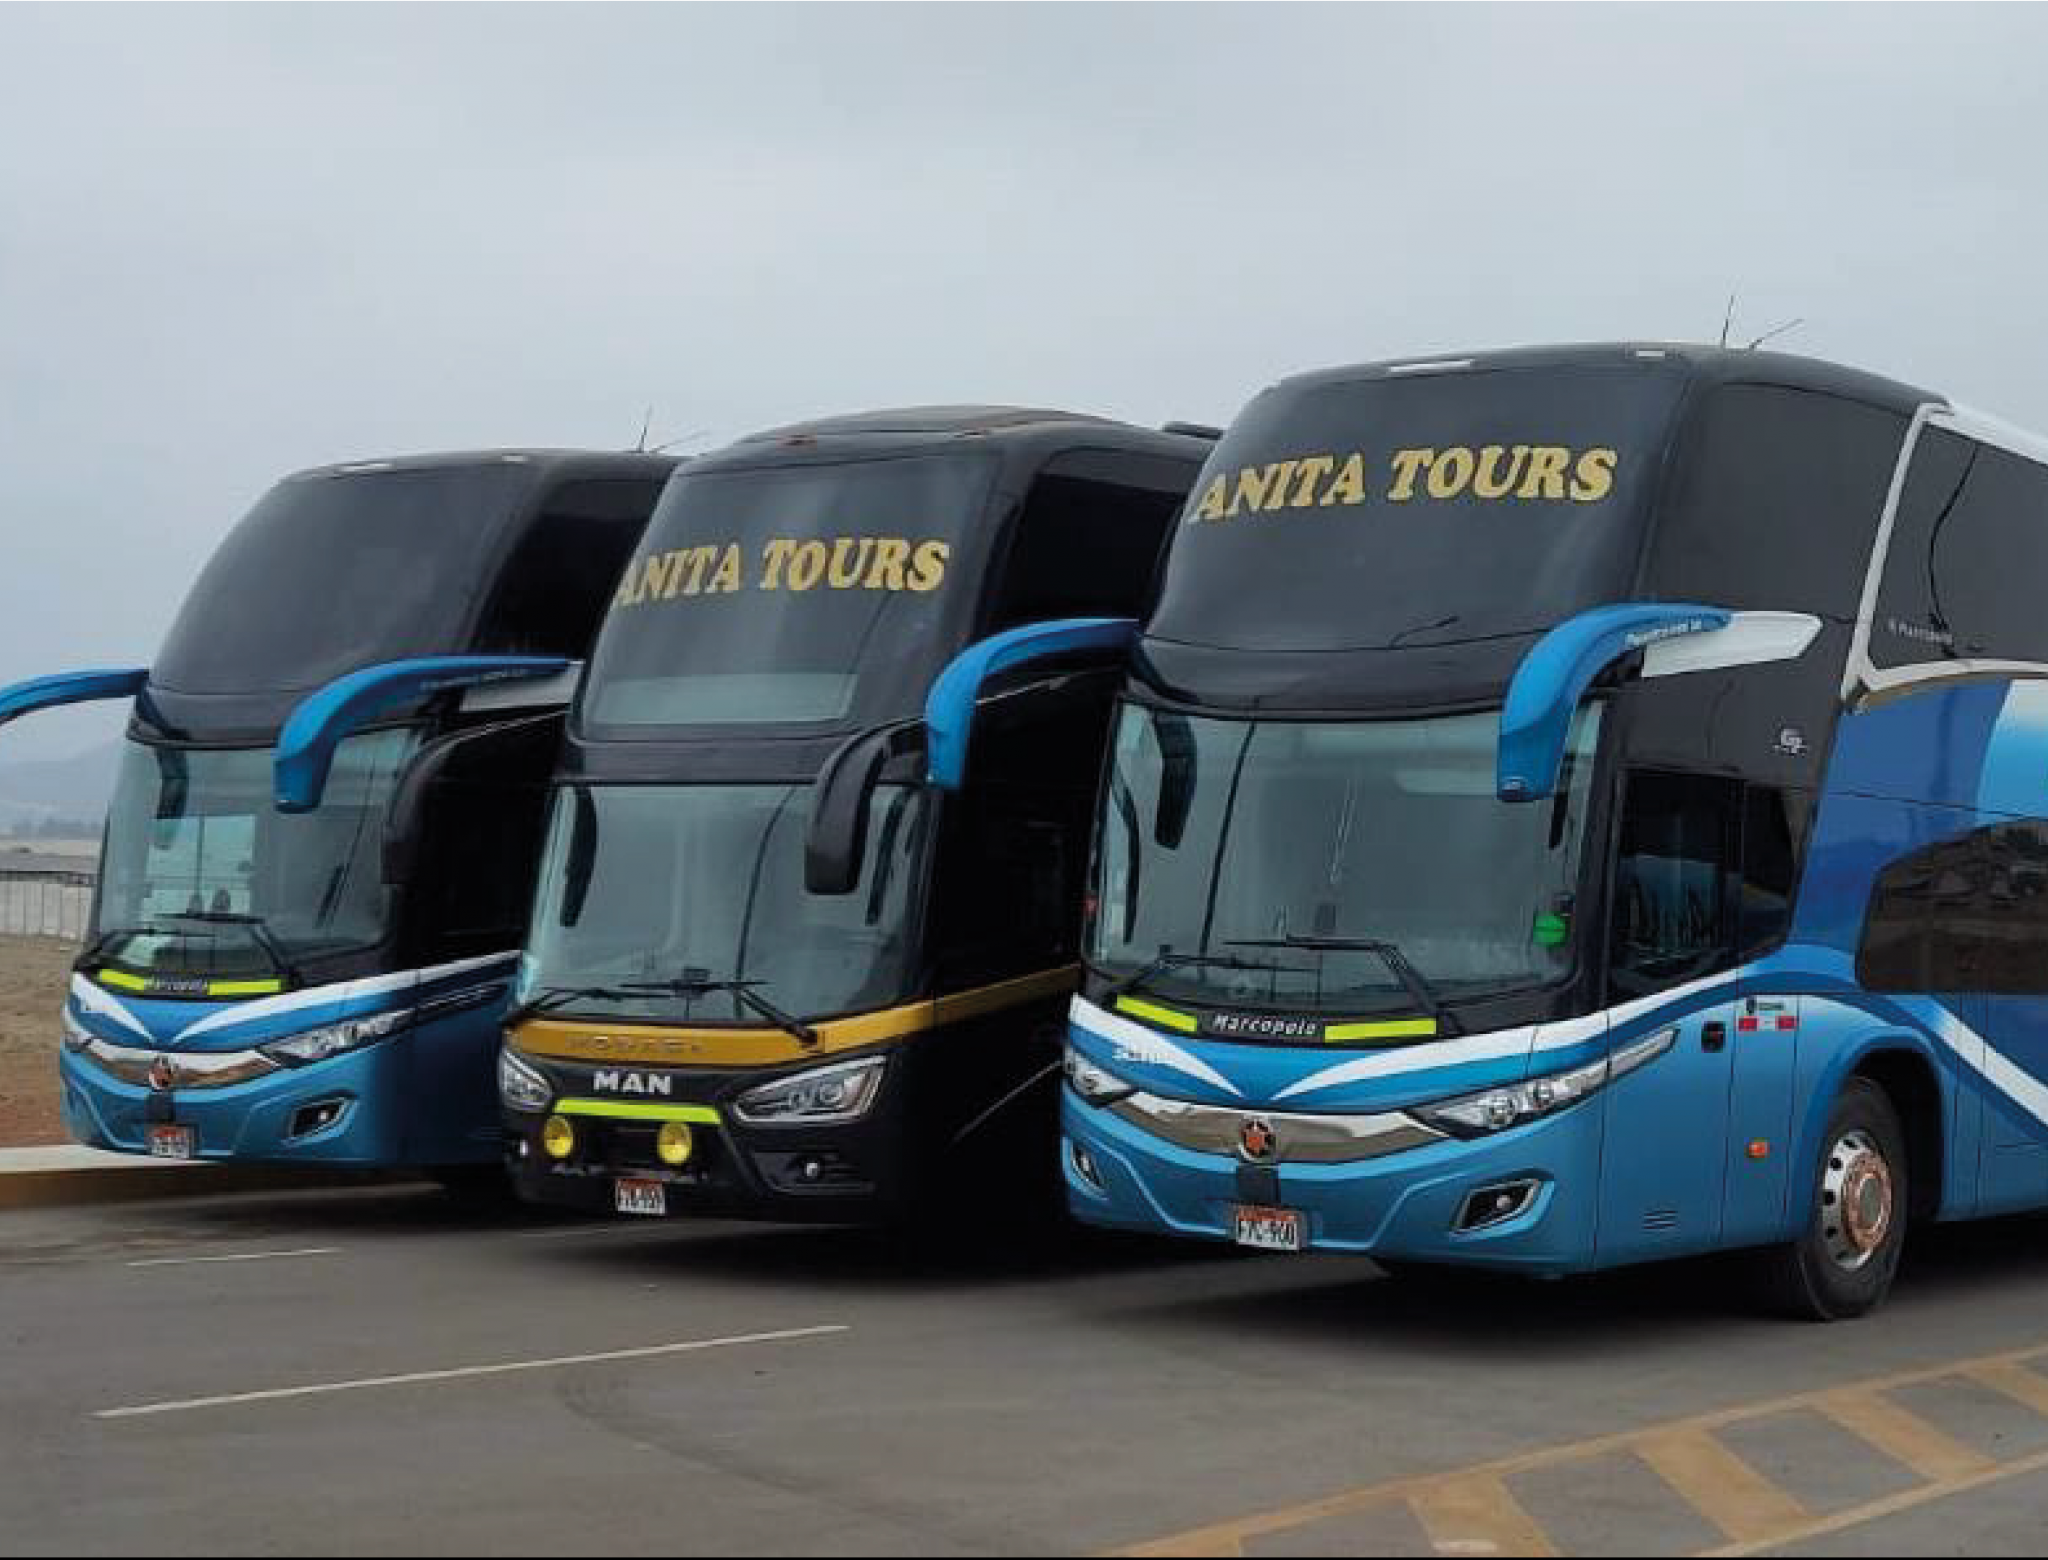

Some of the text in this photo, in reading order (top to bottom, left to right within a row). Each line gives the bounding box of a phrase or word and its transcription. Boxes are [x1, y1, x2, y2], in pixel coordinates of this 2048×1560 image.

[1190, 445, 1618, 523] ANITA TOURS
[760, 537, 951, 592] TOURS
[593, 1070, 671, 1095] MAN
